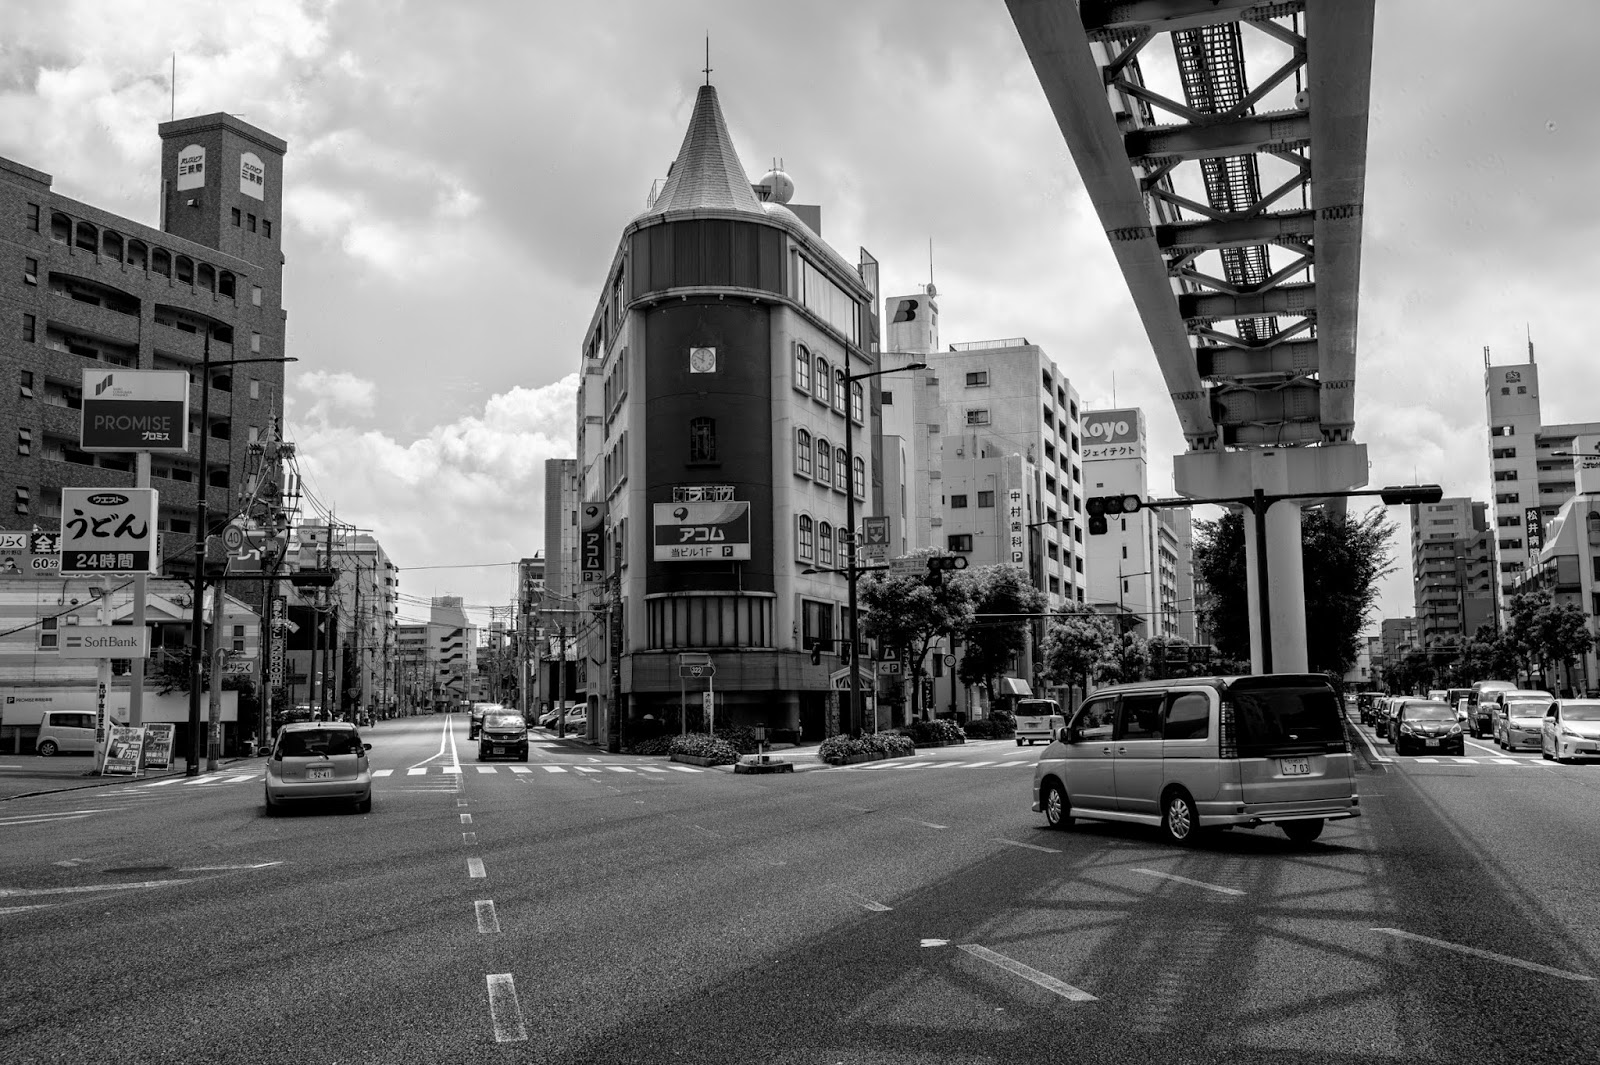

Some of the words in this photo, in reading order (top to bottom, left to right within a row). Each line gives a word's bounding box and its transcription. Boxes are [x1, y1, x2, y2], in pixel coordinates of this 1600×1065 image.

[94, 415, 171, 431] PROMISE
[1080, 416, 1129, 442] Koyo
[142, 431, 170, 440] プロミス
[1083, 446, 1134, 457] ジェイテクト
[93, 496, 123, 504] ウエスト
[66, 508, 148, 540] うどん
[1010, 491, 1022, 547] 中村歯科
[228, 532, 239, 544] 40
[680, 527, 725, 542] アコム
[586, 533, 599, 568] アコム
[671, 547, 712, 557] 当ビル1F
[33, 558, 58, 569] 60分
[76, 553, 134, 568] 24時間
[84, 636, 138, 648] SoftBank
